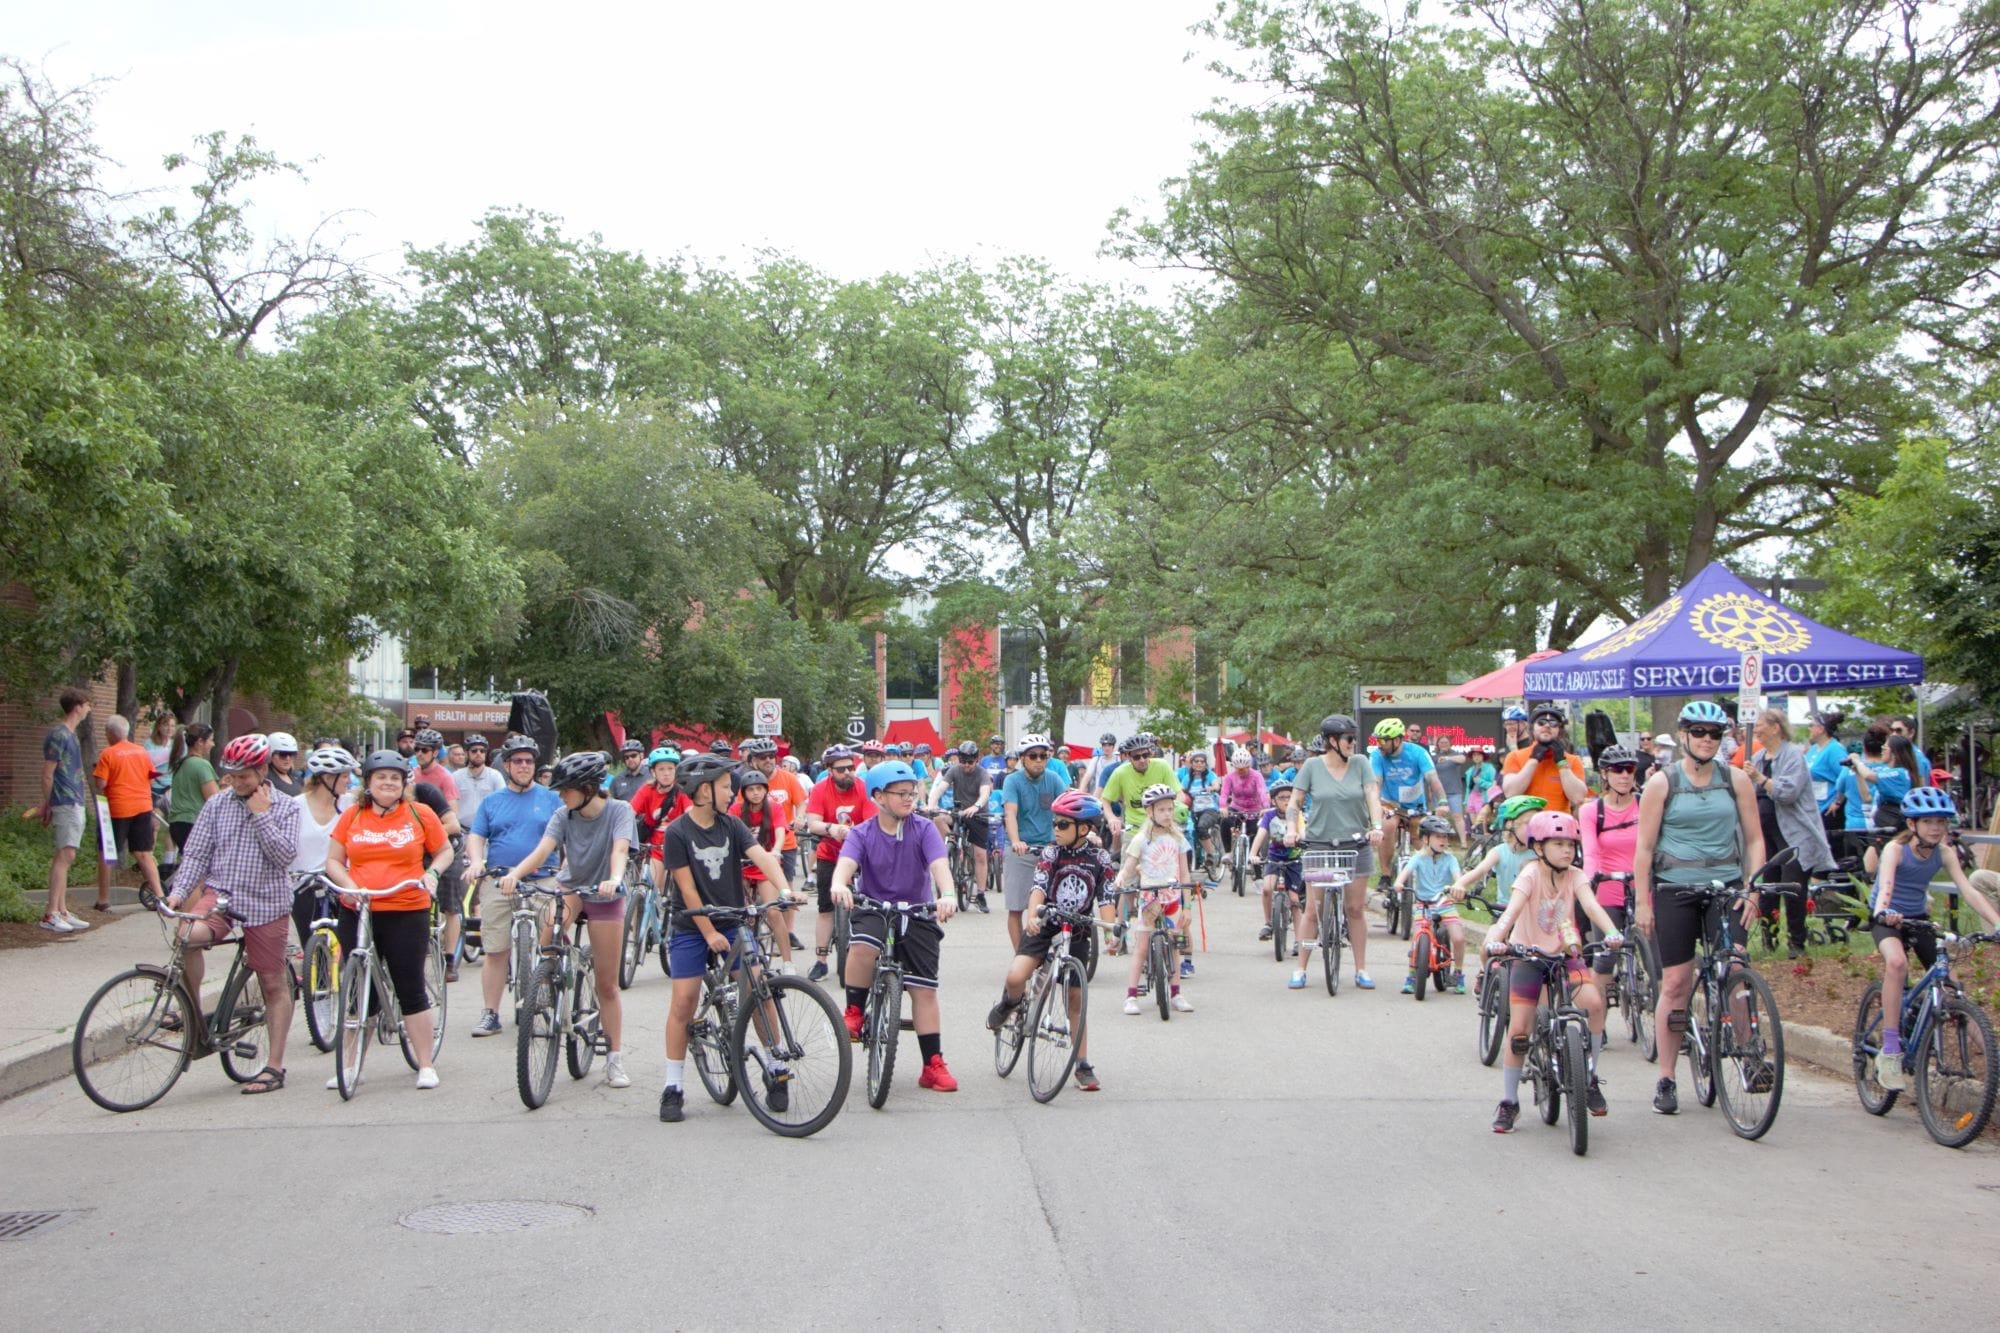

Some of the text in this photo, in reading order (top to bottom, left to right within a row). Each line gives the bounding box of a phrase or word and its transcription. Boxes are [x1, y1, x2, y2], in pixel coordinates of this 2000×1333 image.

[1524, 668, 1626, 692] SERVICE ABOVE SELF
[1633, 664, 1741, 689] SERVICE
[1761, 662, 1839, 685] BOVE
[434, 711, 466, 721] HEALTH
[468, 712, 482, 722] and
